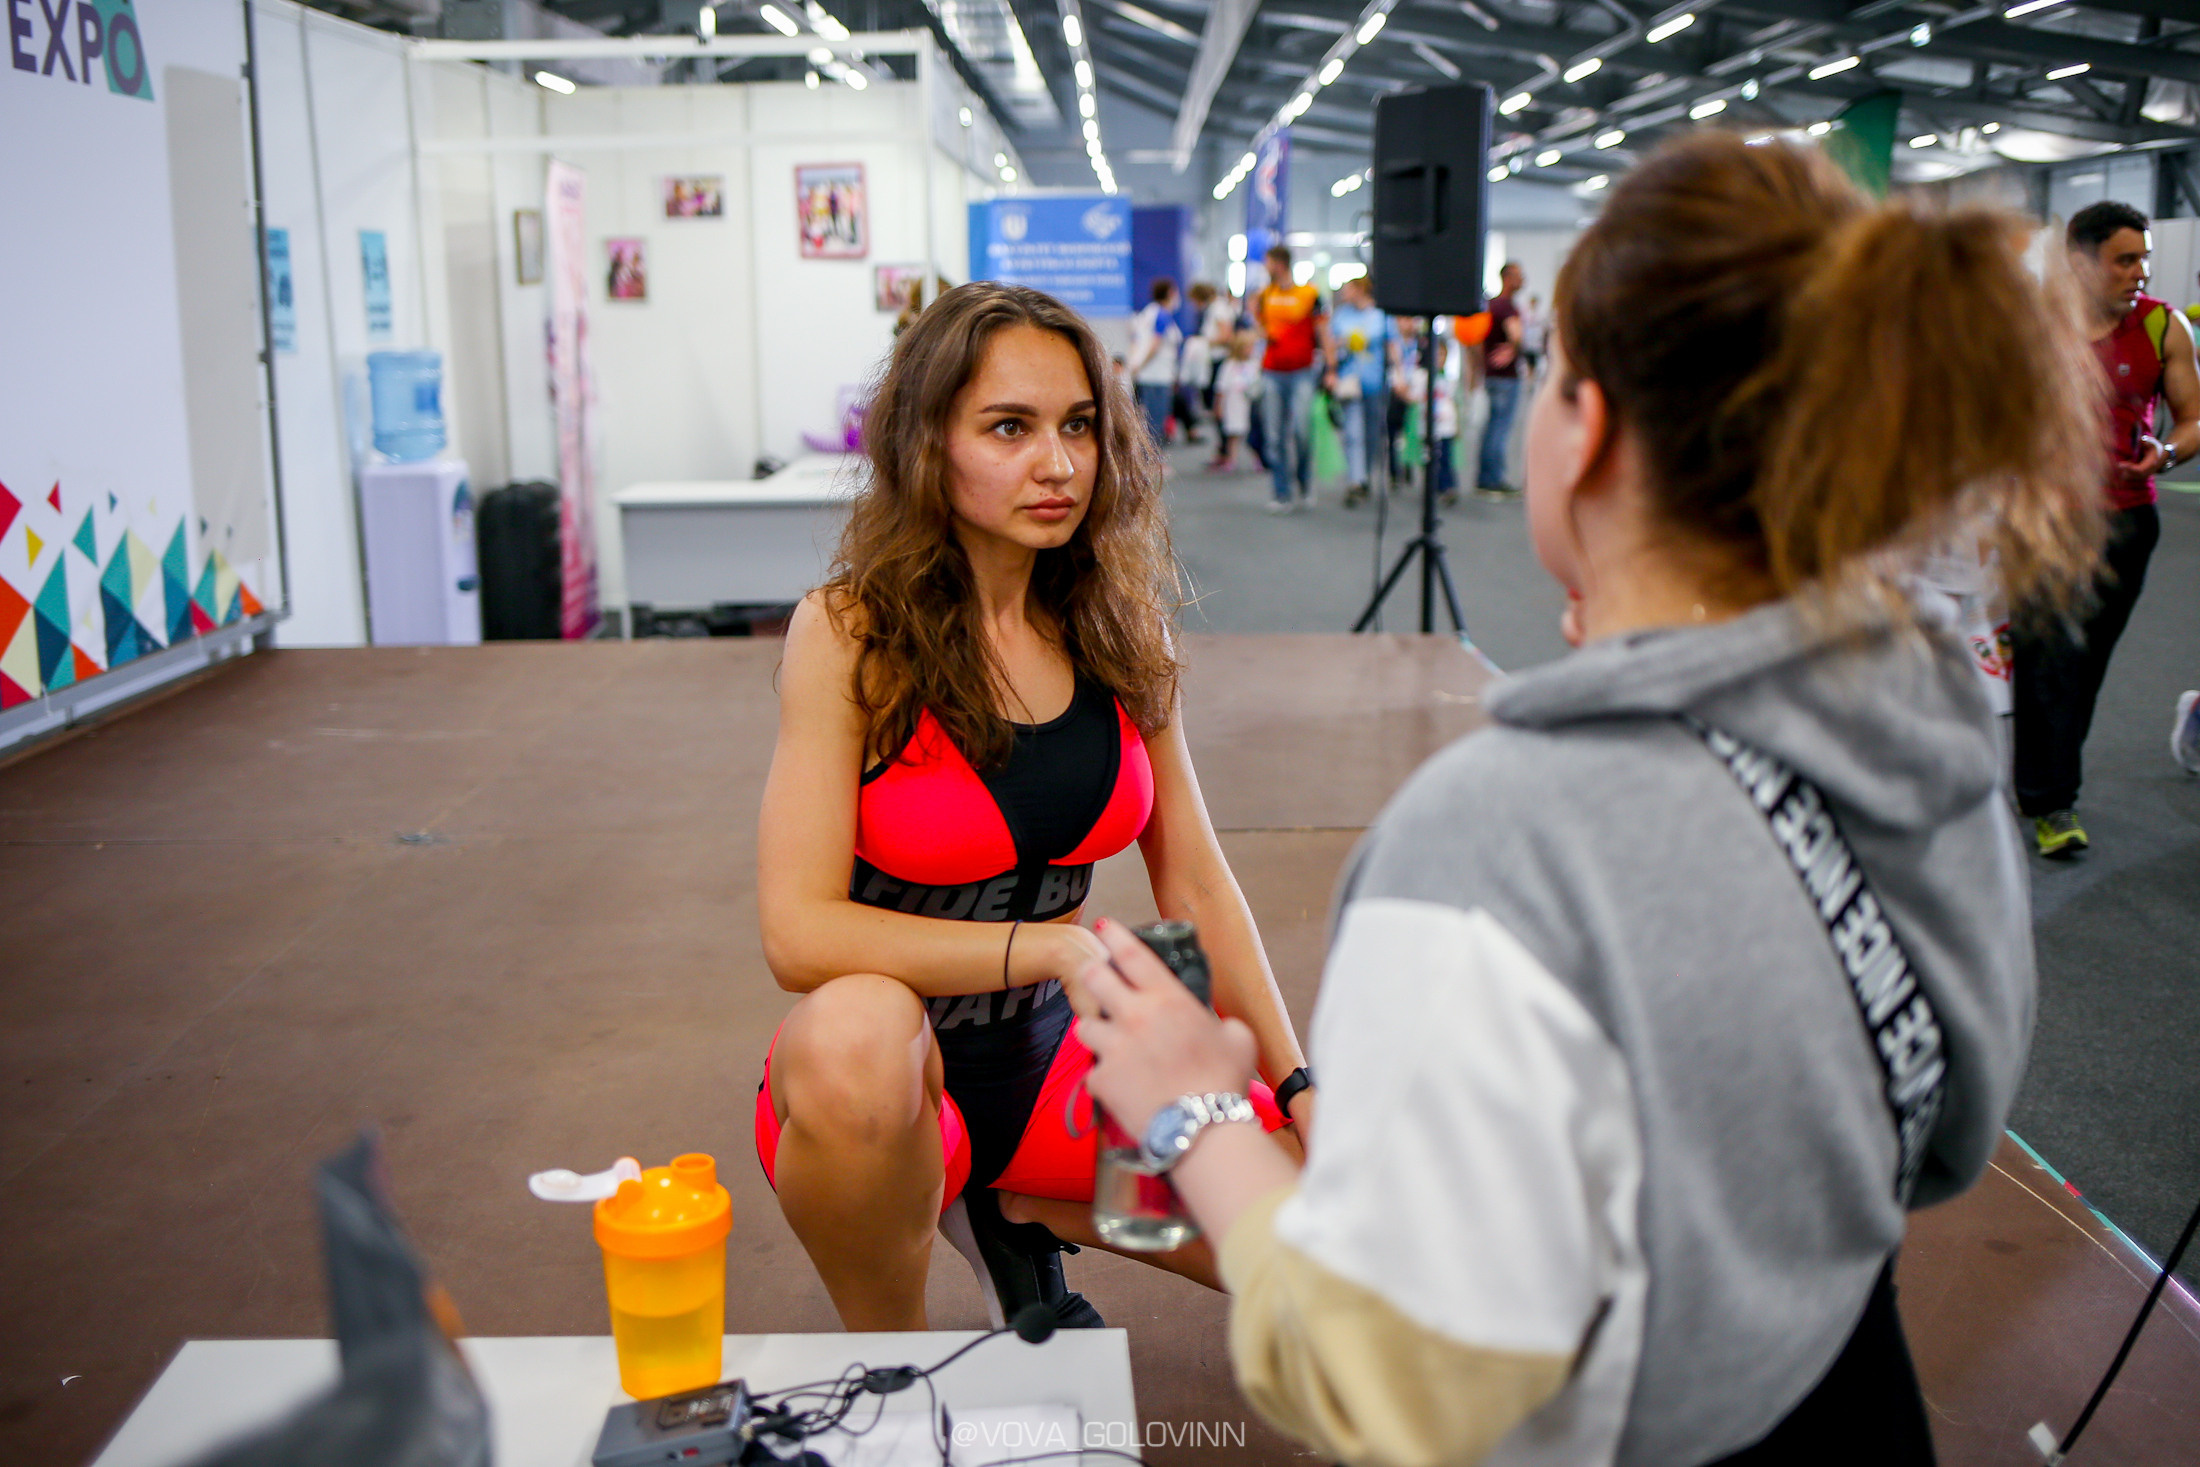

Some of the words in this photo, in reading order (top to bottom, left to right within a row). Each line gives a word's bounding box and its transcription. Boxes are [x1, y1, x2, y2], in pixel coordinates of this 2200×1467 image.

[8, 0, 145, 95] EXPO
[862, 872, 1020, 921] FIDE
[1771, 783, 1862, 920] NICE
[1832, 891, 1917, 1028] NICE
